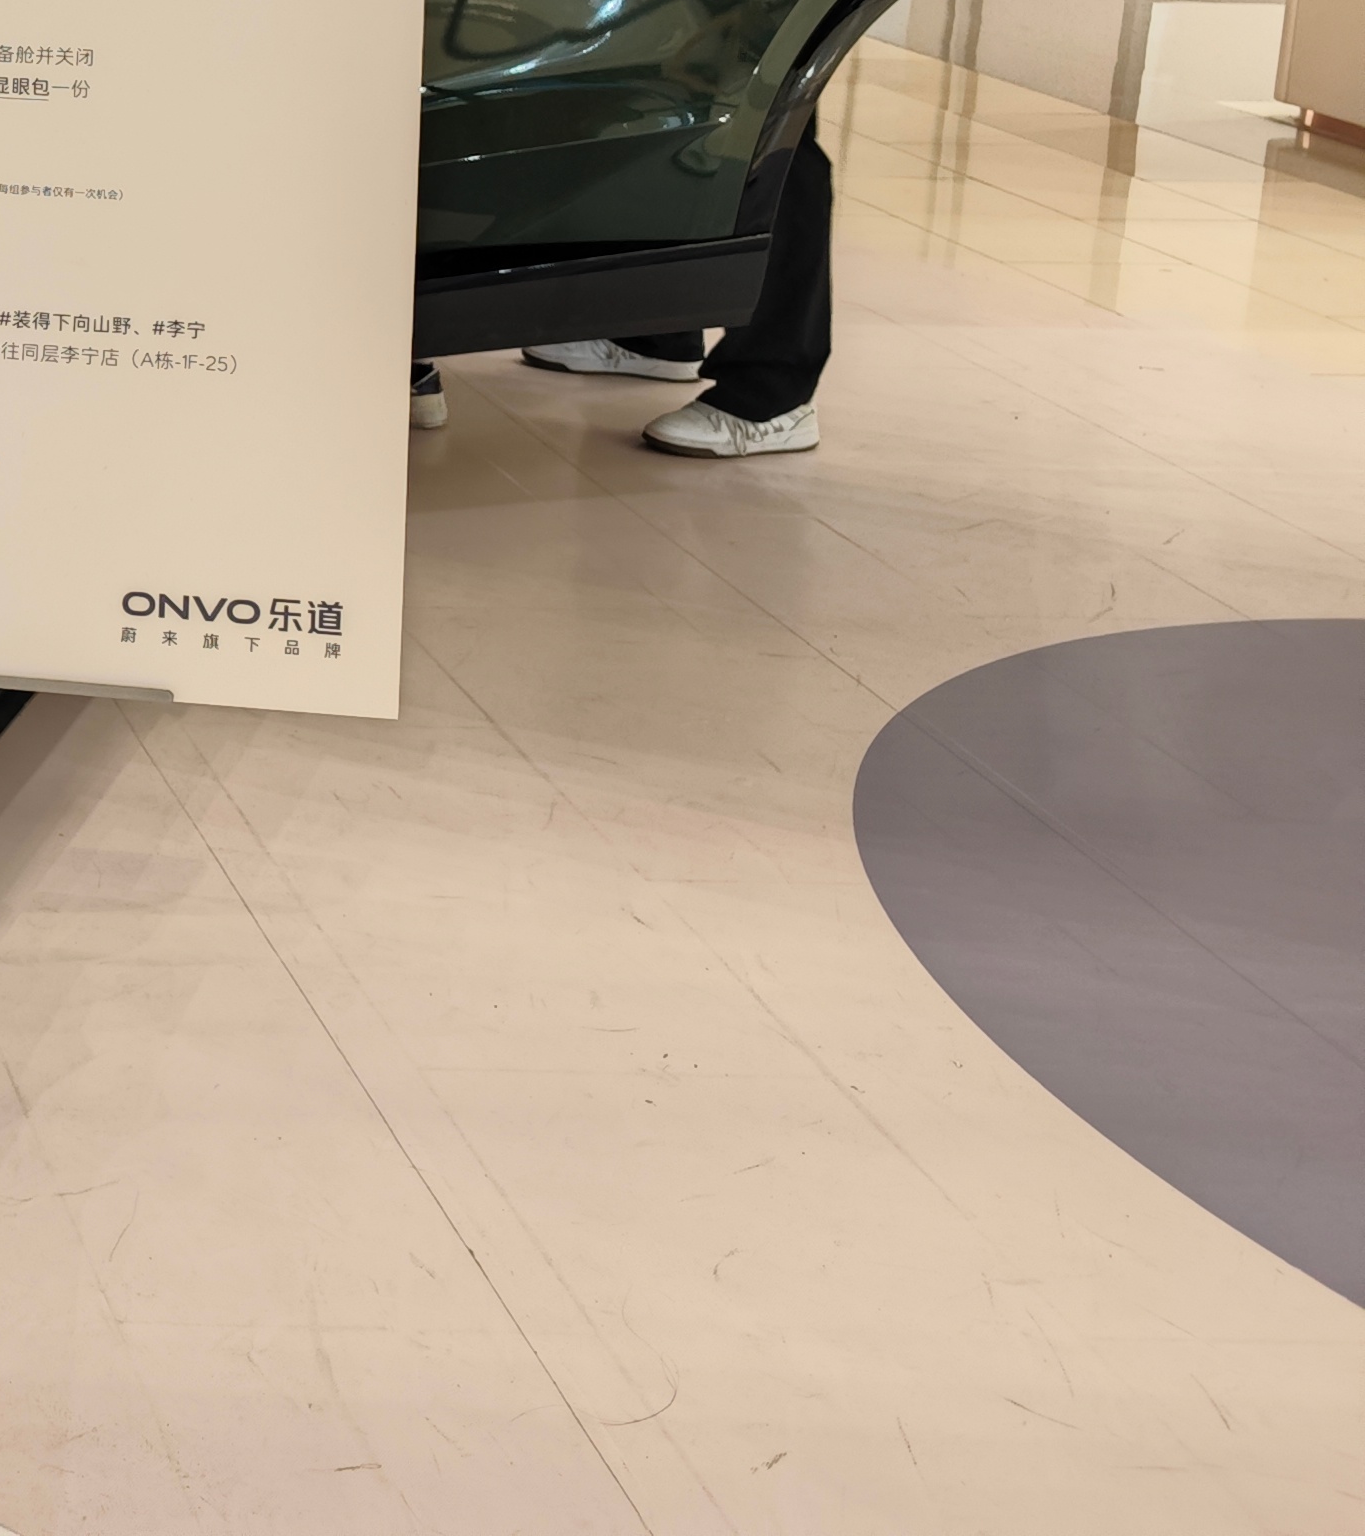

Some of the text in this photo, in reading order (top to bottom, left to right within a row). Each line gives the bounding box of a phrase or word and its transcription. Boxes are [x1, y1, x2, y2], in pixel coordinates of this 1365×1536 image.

[120, 626, 342, 660] 蔚来旗下品牌
